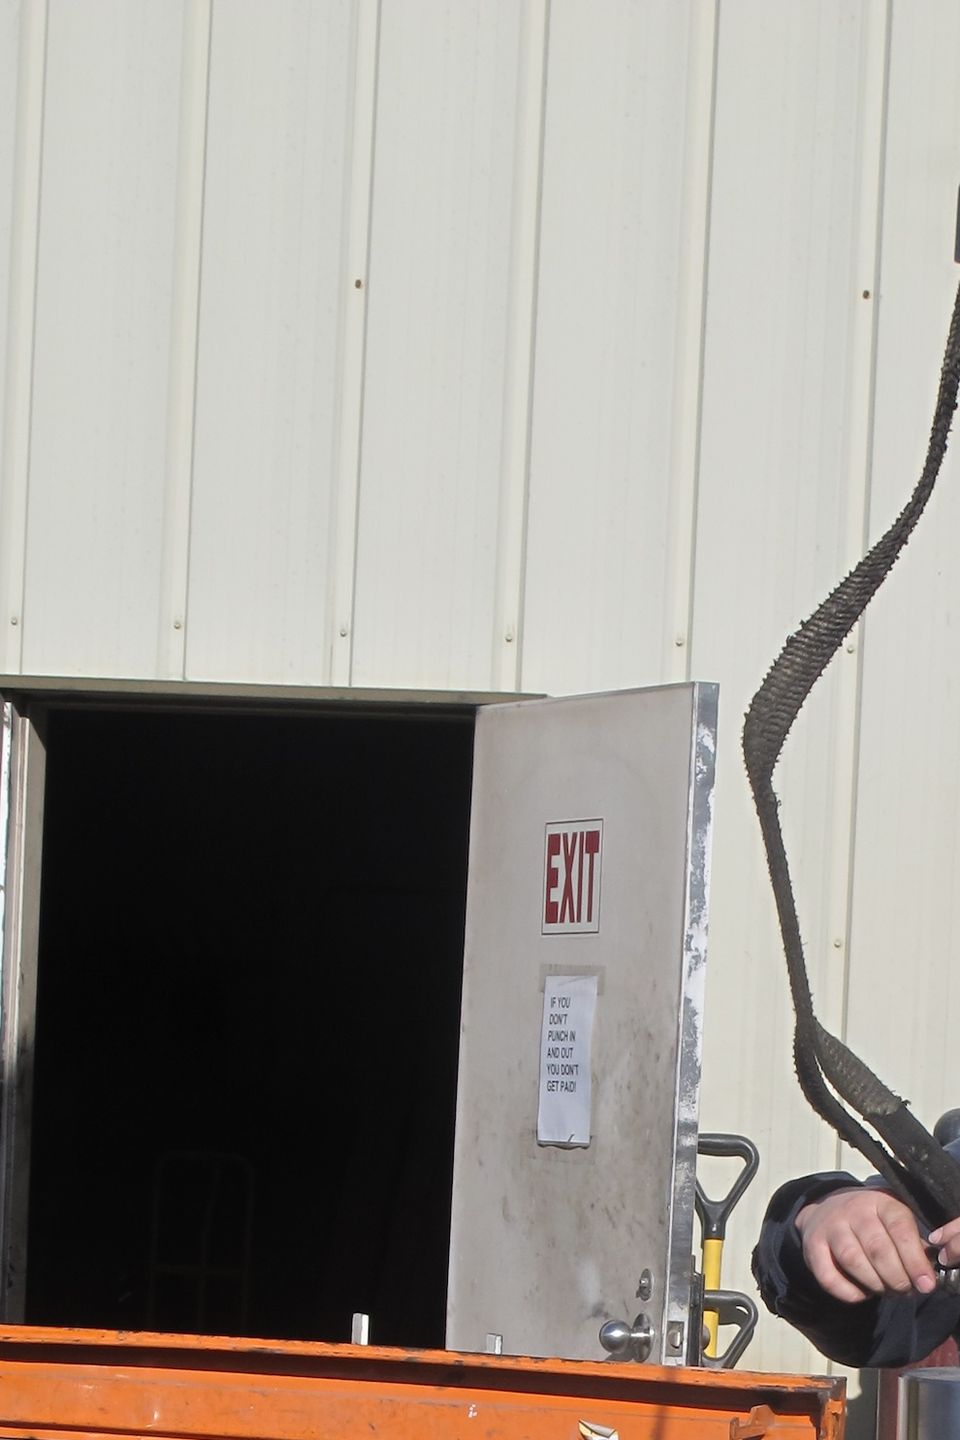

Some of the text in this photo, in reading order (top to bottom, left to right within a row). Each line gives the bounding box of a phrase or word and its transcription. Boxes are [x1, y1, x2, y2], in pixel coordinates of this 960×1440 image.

[545, 830, 600, 923] EXIT
[550, 996, 571, 1008] IF YOU
[549, 1013, 568, 1024] DON'T
[547, 1030, 576, 1041] PUNCH IN
[547, 1047, 573, 1058] AND OUT
[546, 1063, 579, 1075] YOU DON'T
[547, 1080, 559, 1091] GET
